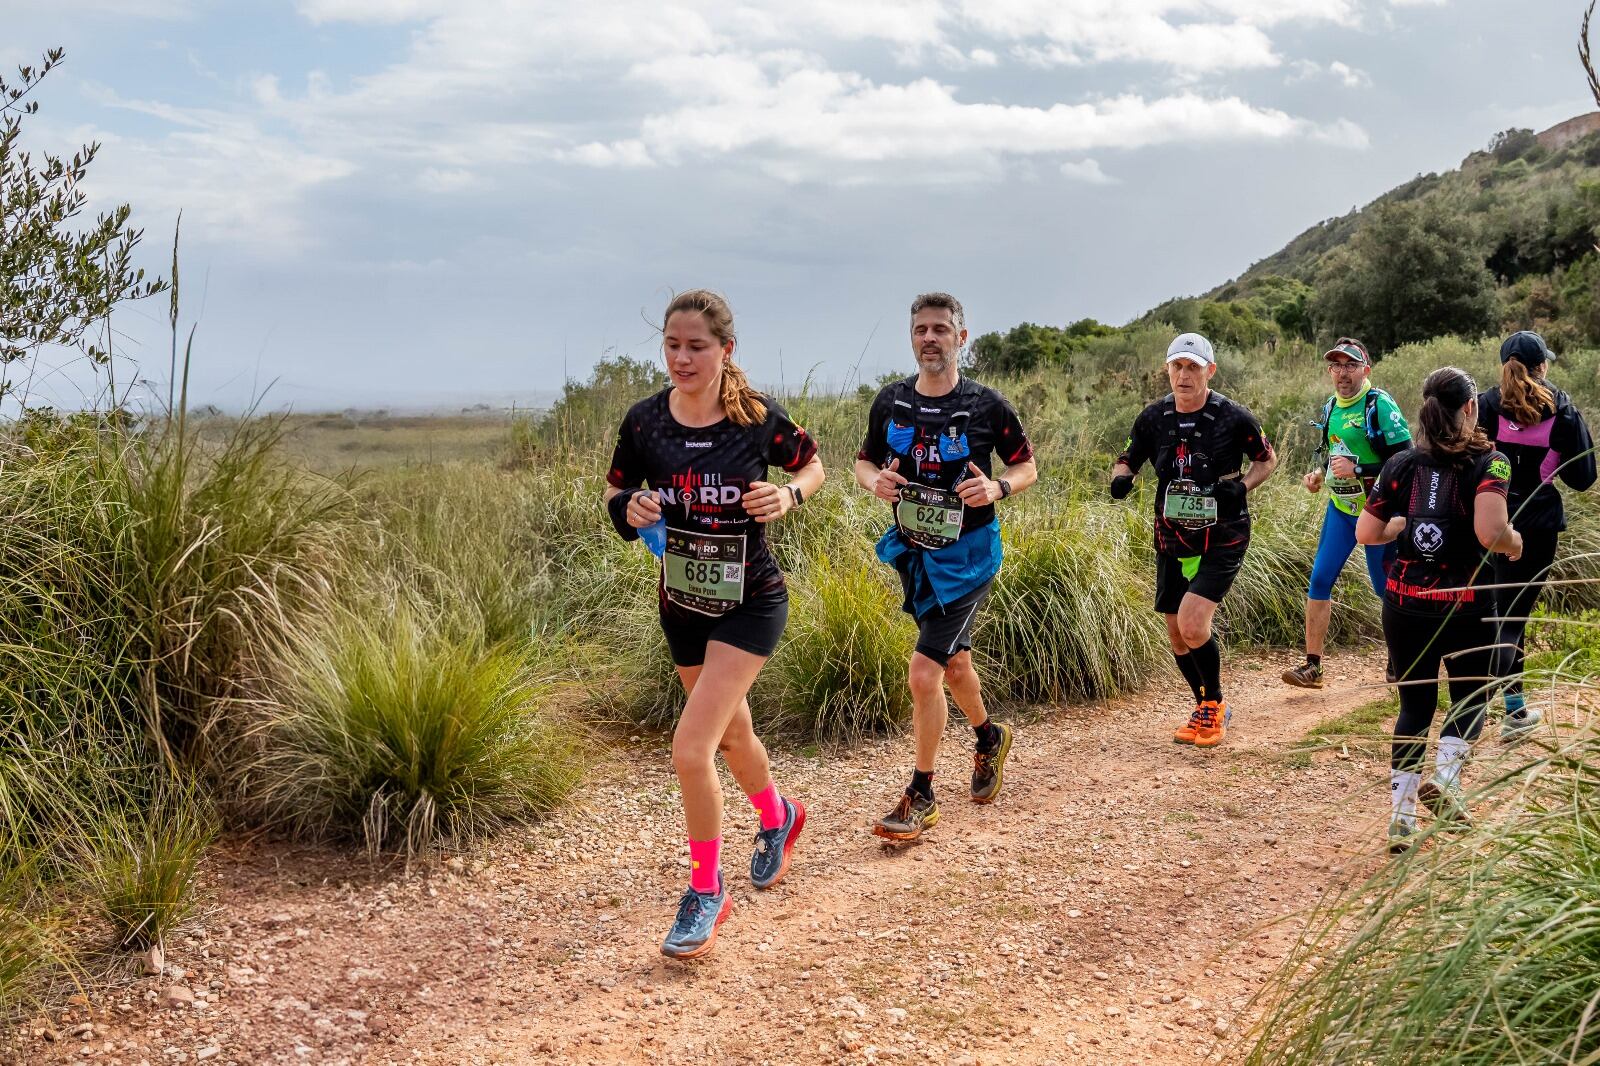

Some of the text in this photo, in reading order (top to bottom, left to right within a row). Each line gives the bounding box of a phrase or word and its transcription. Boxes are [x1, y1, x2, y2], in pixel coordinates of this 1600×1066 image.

[704, 472, 723, 486] DEL
[658, 486, 741, 505] NORD
[1180, 497, 1203, 511] 735
[1428, 491, 1437, 510] MAX
[916, 506, 945, 525] 624
[726, 545, 737, 553] 14
[685, 560, 721, 585] 685
